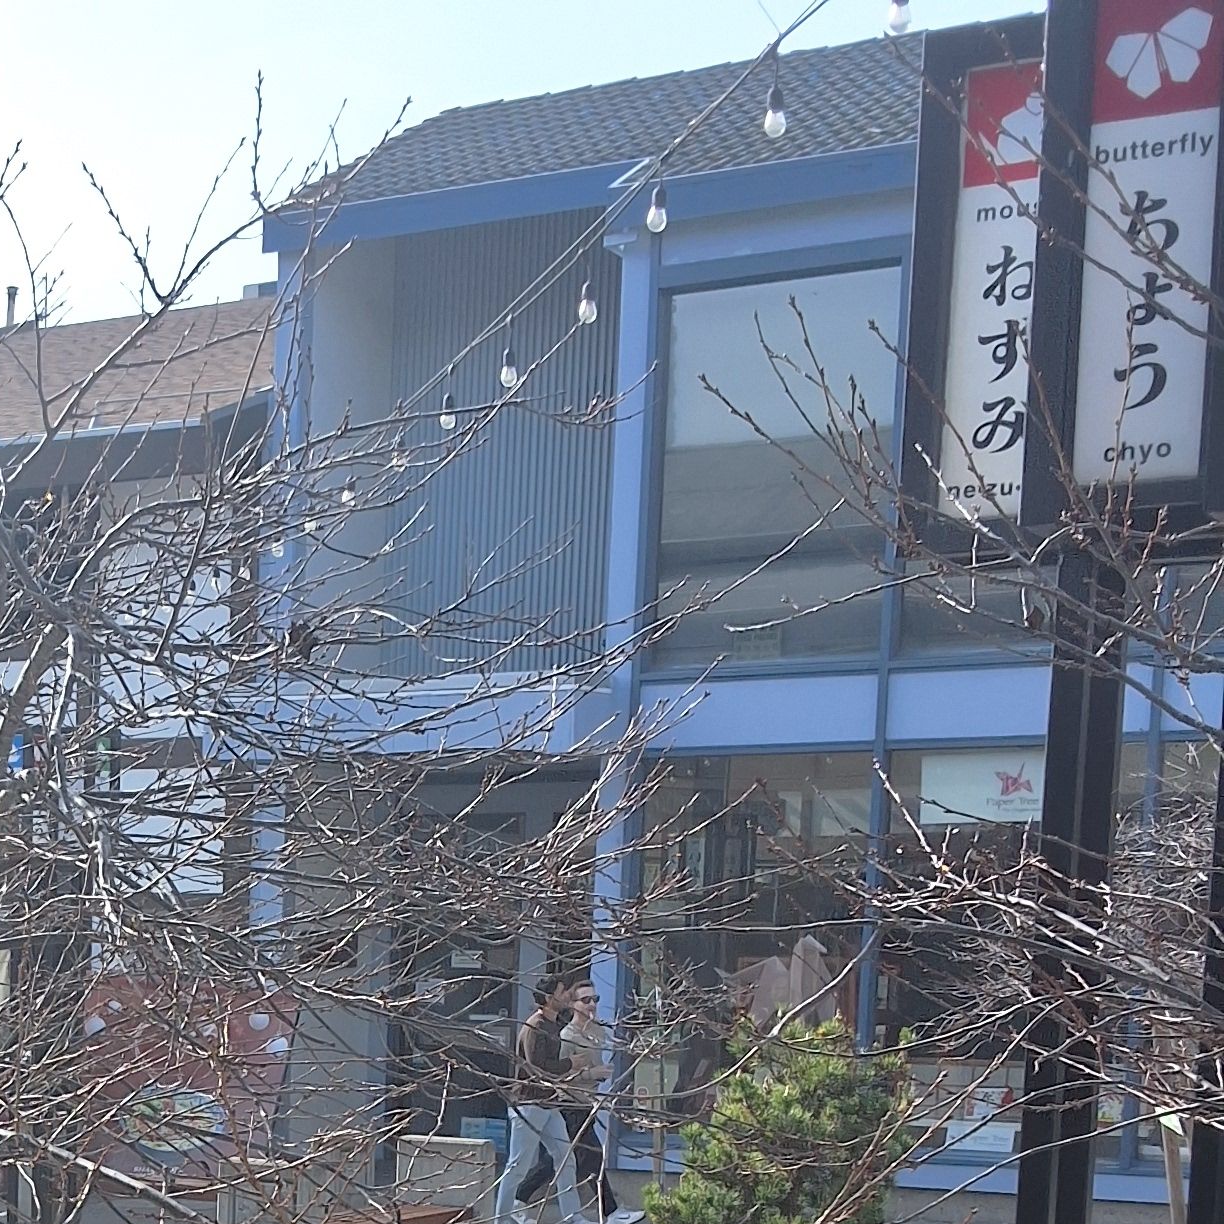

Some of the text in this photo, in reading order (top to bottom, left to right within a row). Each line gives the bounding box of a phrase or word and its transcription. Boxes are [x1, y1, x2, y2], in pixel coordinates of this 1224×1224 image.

[1095, 131, 1214, 165] butterfly
[1114, 190, 1180, 411] ちょう
[1103, 440, 1172, 465] chyo
